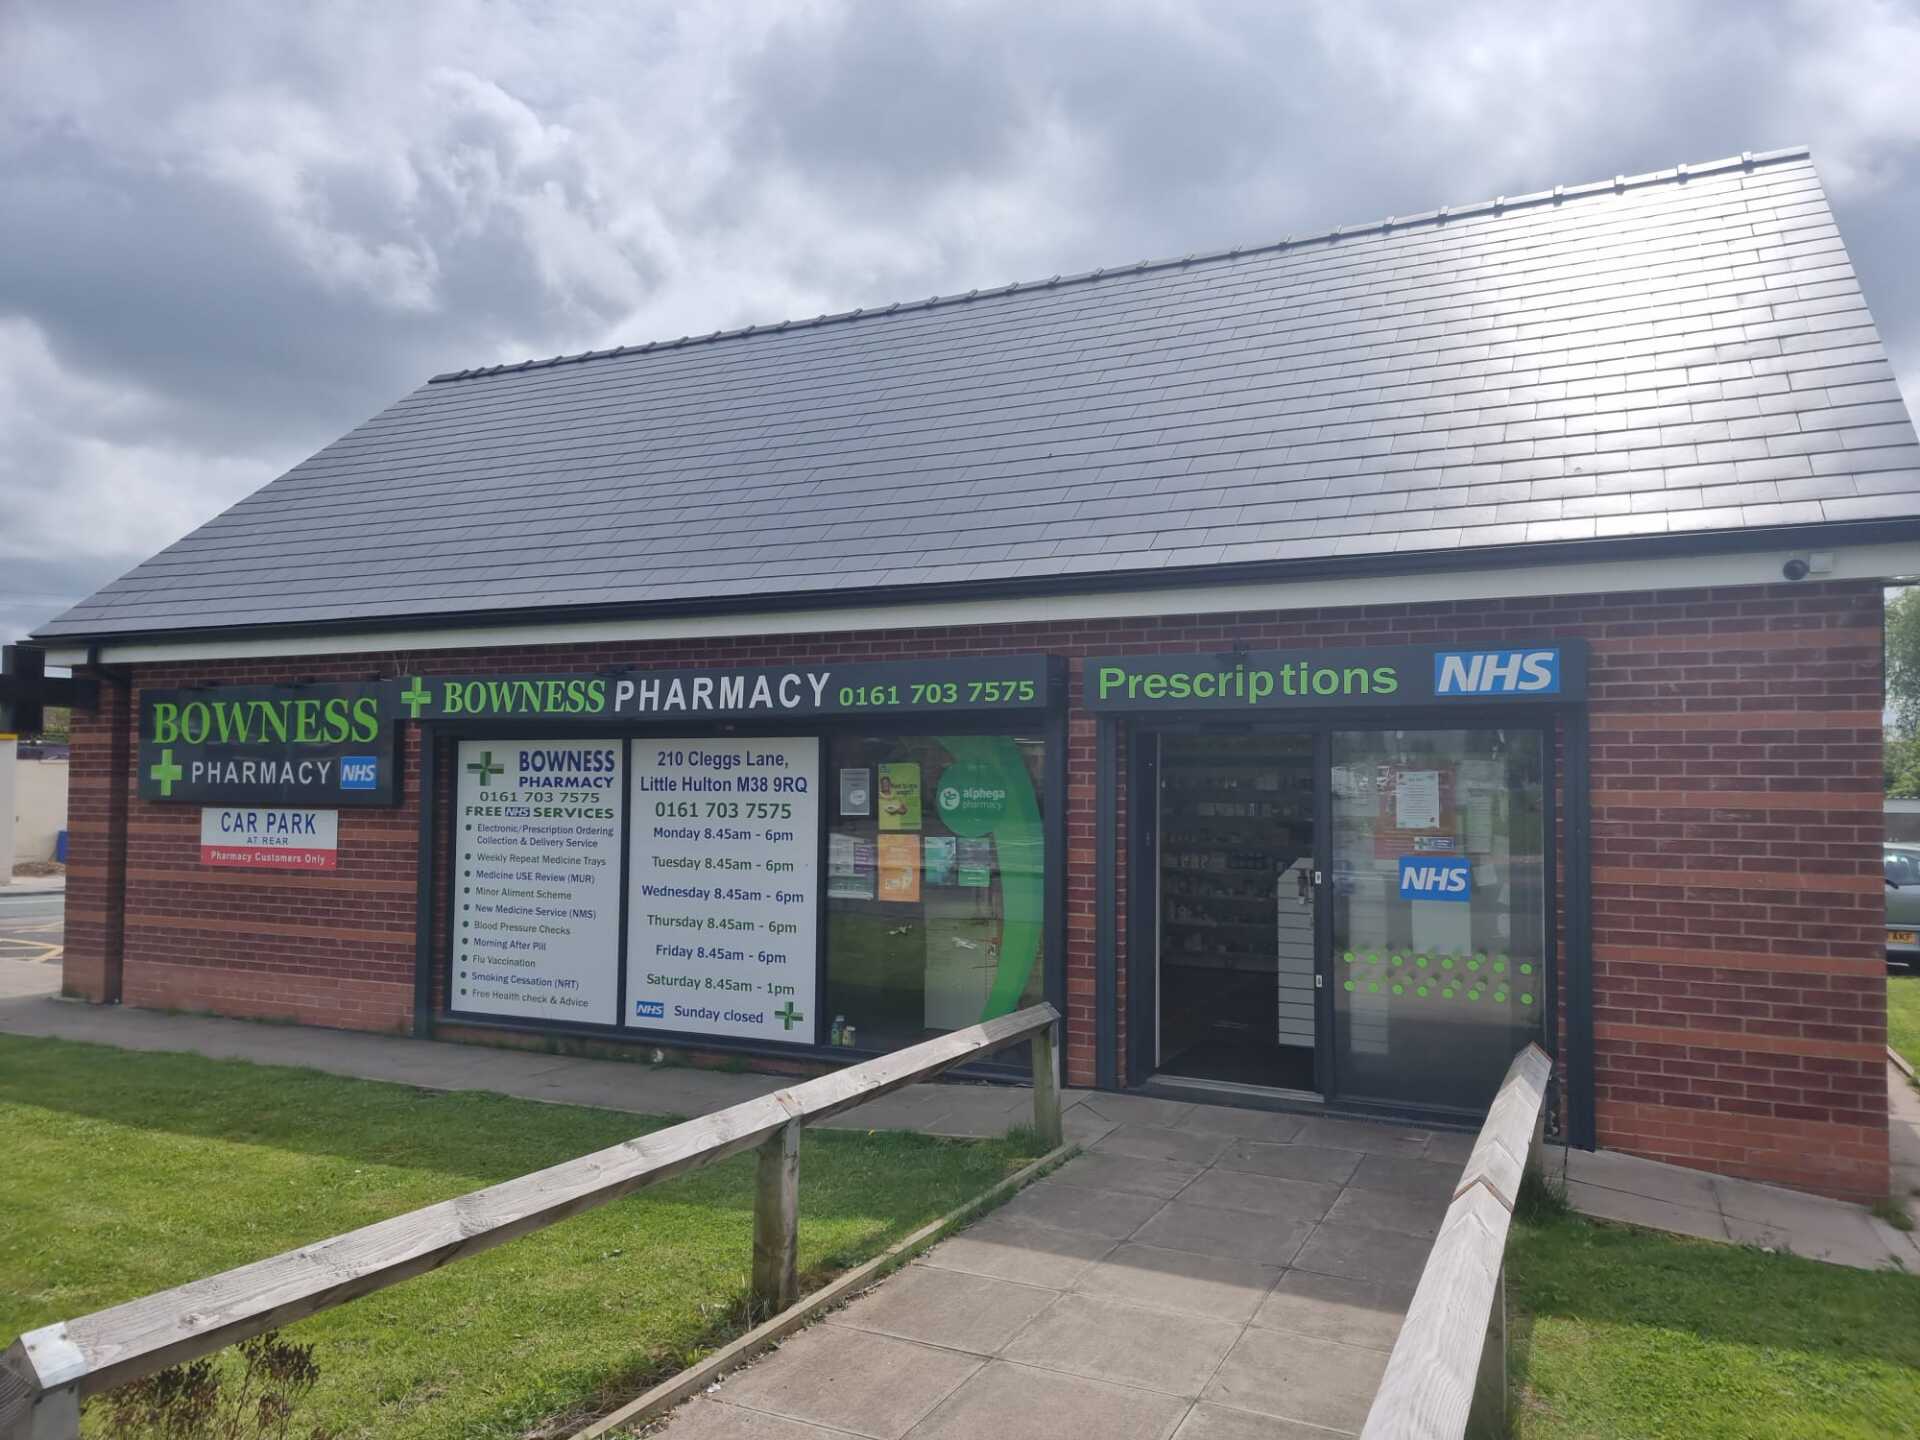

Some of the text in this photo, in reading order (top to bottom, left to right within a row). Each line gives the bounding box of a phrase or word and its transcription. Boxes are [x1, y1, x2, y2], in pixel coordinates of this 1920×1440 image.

[1099, 652, 1554, 704] Prescriptions NHS
[442, 672, 1034, 713] BOWNESS PHARMACY 0161 703 7575
[152, 698, 378, 744] BOWNESS
[519, 750, 615, 772] BOWNESS
[657, 750, 789, 769] 210 Cleggs Lane,
[192, 761, 376, 784] PHARMACY NHS
[519, 776, 614, 788] PHARMACY
[640, 776, 808, 793] Little Hulton M38 9RQ
[480, 791, 600, 803] 0161 703 7575
[963, 787, 1005, 800] alphega
[465, 806, 614, 819] FREE NHS SERVICES
[655, 802, 792, 819] 0161 703 7575
[221, 811, 316, 835] CAR PARK
[576, 825, 614, 837] Ordering
[247, 837, 289, 845] AT REAR
[477, 836, 598, 848] Collection & Delivery Service
[653, 827, 700, 841] Monday
[704, 828, 751, 840] 8.45am
[765, 829, 793, 843] 6pm
[211, 850, 325, 865] Pharmacy Customers Only
[477, 853, 606, 866] Weekly Repeat Medicine Trays
[652, 856, 701, 870] Tuesday
[705, 858, 751, 870] 8.45am
[766, 860, 794, 873] 6pm
[476, 870, 595, 884] Medicine USE Review (MUR)
[1401, 867, 1467, 891] NHS
[476, 886, 499, 896] Minor
[536, 889, 572, 900] Scheme
[641, 885, 710, 900] Wednesday
[714, 888, 762, 901] 8.45am
[775, 891, 804, 904] 6pm
[475, 903, 597, 920] New Medicine Service (NMS)
[474, 921, 570, 935] Blood Pressure Checks
[647, 914, 703, 930] Thursday
[707, 918, 754, 931] 8.45am
[768, 921, 797, 935] 6pm
[474, 938, 547, 951] Morning After Pill
[472, 954, 536, 968] Flu Vaccination
[656, 944, 693, 960] Friday
[697, 947, 744, 961] 8.45am
[758, 951, 786, 965] 6pm
[472, 972, 580, 990] Smoking Cessation (NRT)
[647, 973, 701, 989] Saturday
[704, 978, 752, 992] 8.45am
[767, 982, 795, 996] 1pm
[472, 989, 589, 1007] Free Health check & Advice
[636, 1005, 764, 1023] NHS Sunday closed
